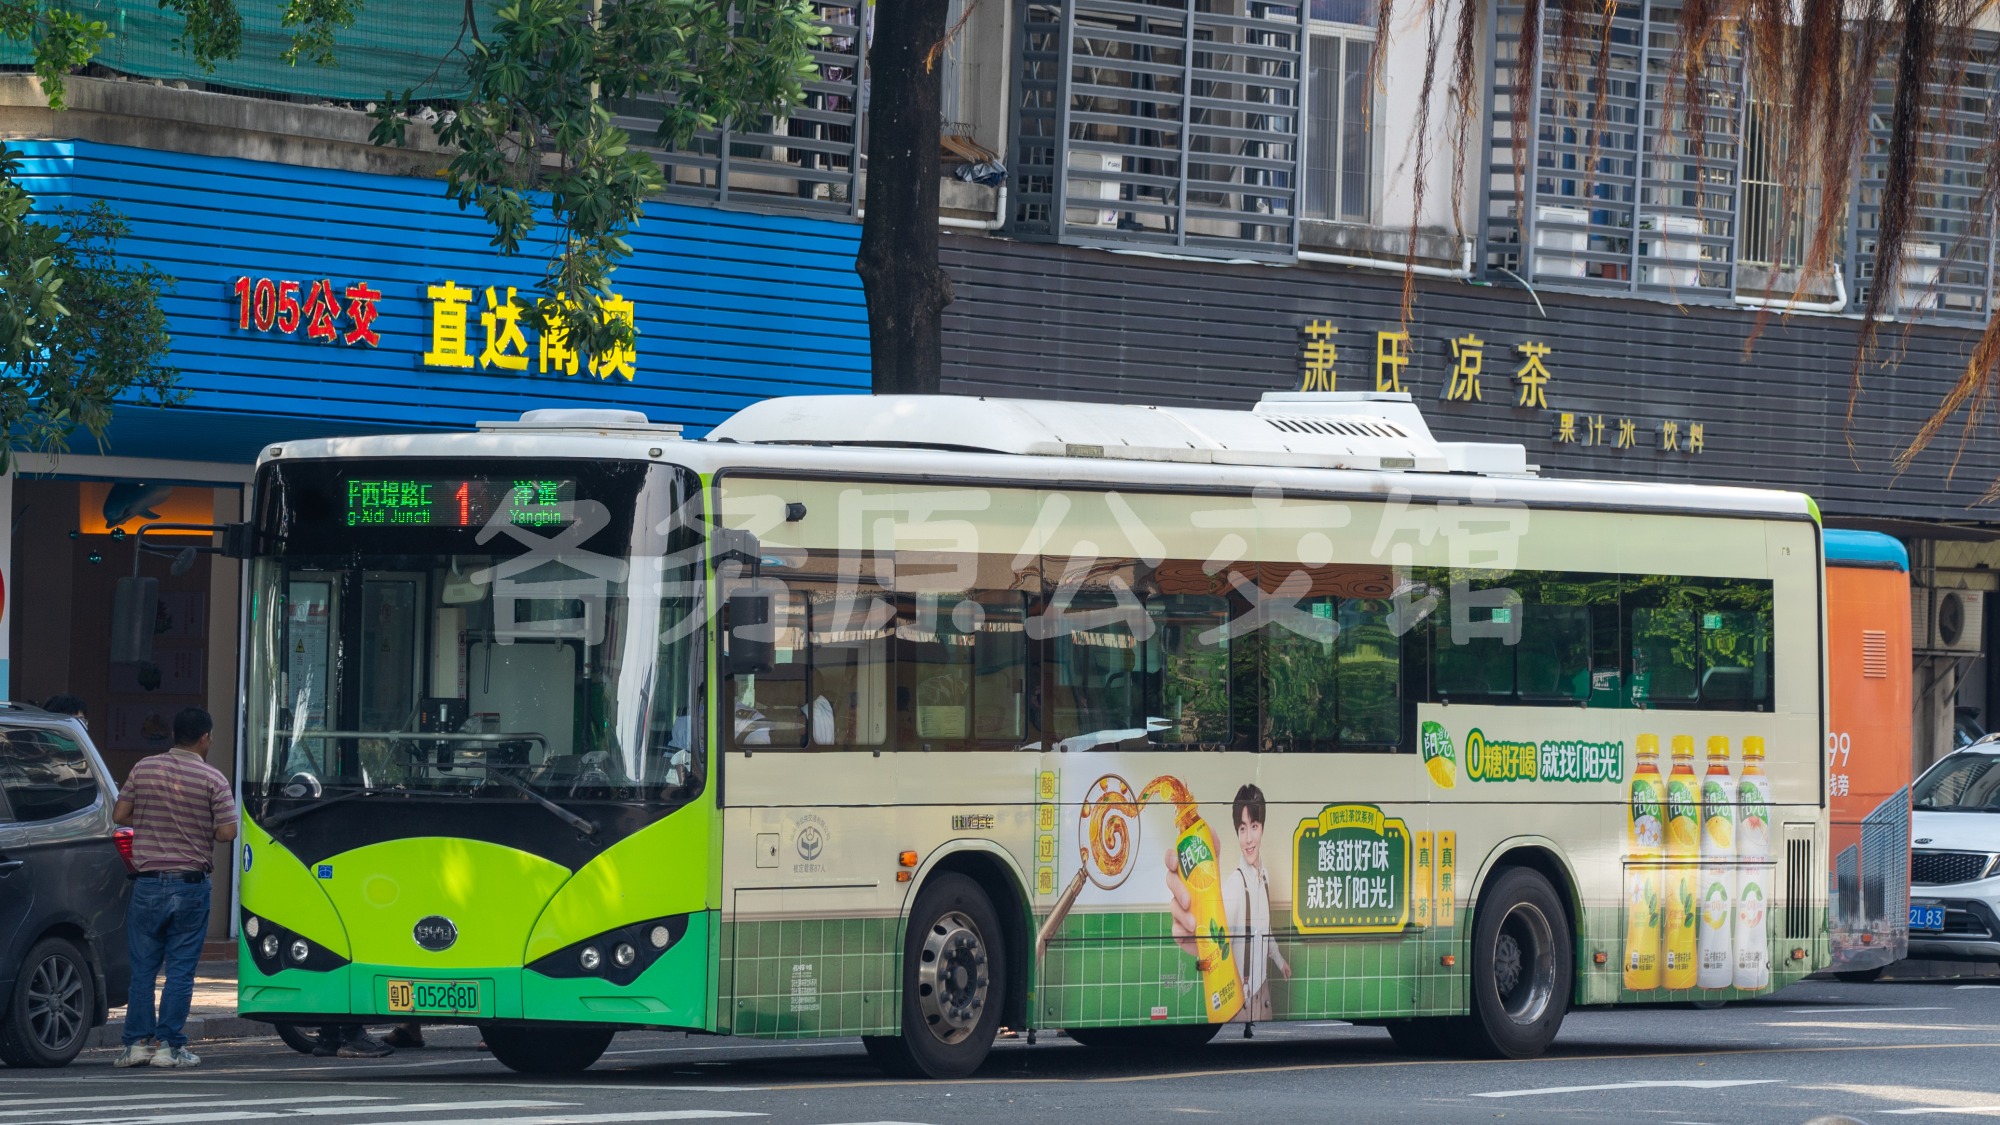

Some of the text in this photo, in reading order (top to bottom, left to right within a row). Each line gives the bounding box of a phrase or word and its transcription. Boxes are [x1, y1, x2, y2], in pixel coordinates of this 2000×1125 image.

[235, 276, 381, 348] 105公交
[1301, 320, 1551, 409] 萧氏凉茶
[456, 482, 468, 525] 1
[510, 510, 560, 526] Yangbin
[1040, 776, 1054, 889] 酸甜过瘾
[1318, 839, 1389, 871] 酸甜好味
[1441, 847, 1453, 917] 真果汁
